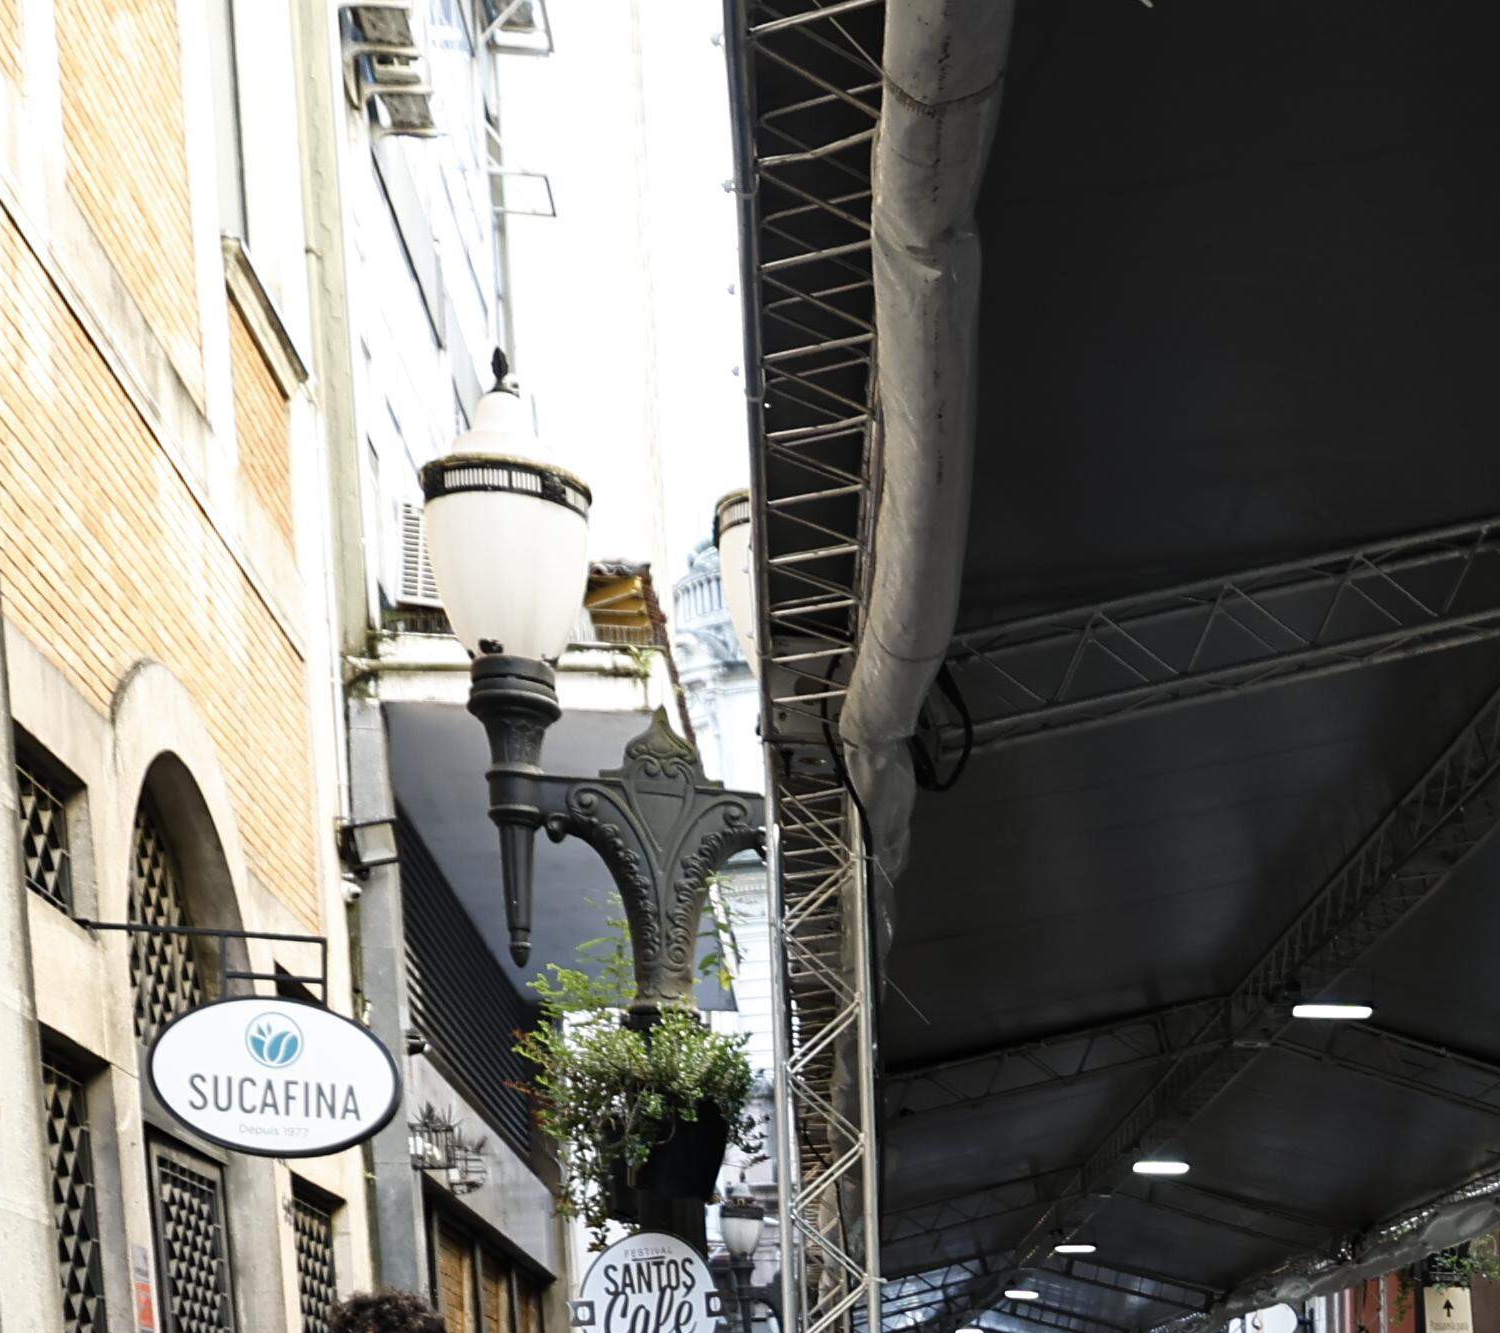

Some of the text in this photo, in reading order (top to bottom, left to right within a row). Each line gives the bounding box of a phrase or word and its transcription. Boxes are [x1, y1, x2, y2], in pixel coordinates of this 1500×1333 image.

[189, 1073, 361, 1121] SUCAFINA
[239, 1123, 279, 1136] Depuis
[624, 1248, 673, 1257] FESTIVAL
[603, 1257, 695, 1296] SANTOS
